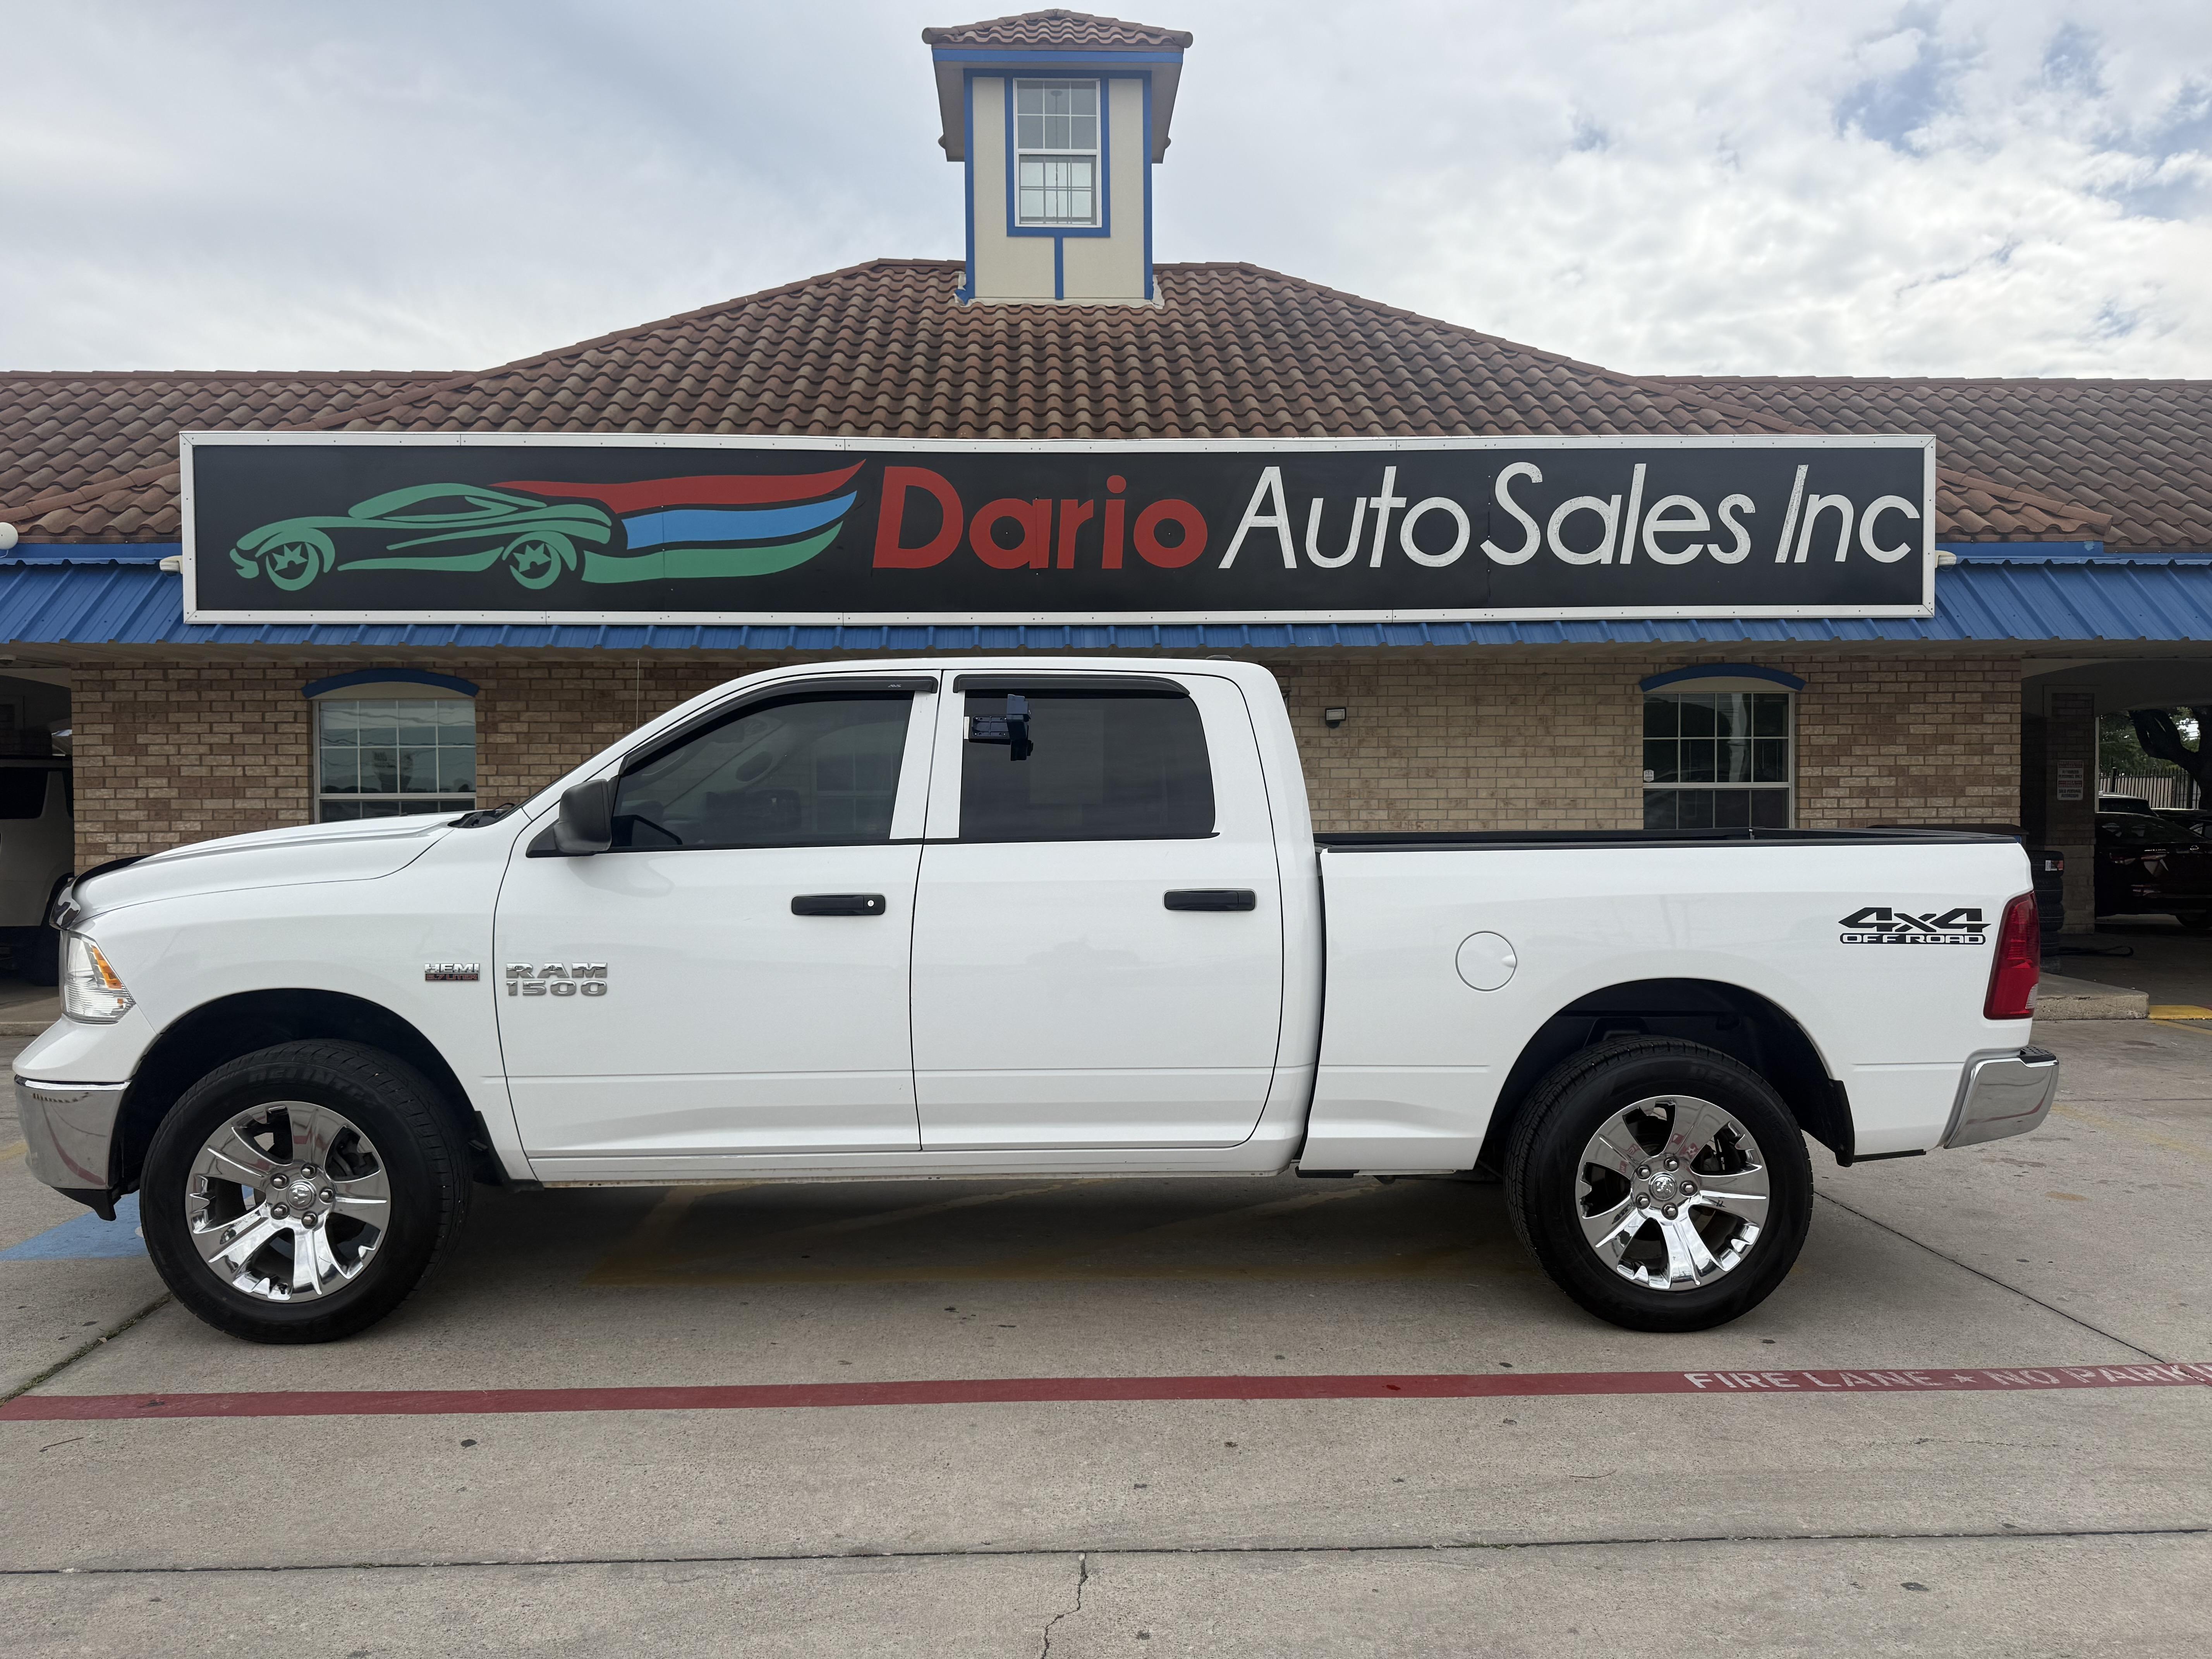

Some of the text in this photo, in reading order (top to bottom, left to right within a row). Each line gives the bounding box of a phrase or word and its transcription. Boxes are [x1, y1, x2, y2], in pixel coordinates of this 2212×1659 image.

[873, 462, 1920, 569] Dario Auto Sales Inc
[1838, 907, 1992, 933] 4x4
[1842, 934, 1984, 943] OFF ROAD
[424, 963, 480, 972] HEMI
[506, 962, 608, 979] RAM
[506, 980, 608, 996] 1500
[1684, 1372, 1800, 1388] FIRE
[1802, 1371, 1943, 1388] LANE
[1980, 1369, 2060, 1385] NO
